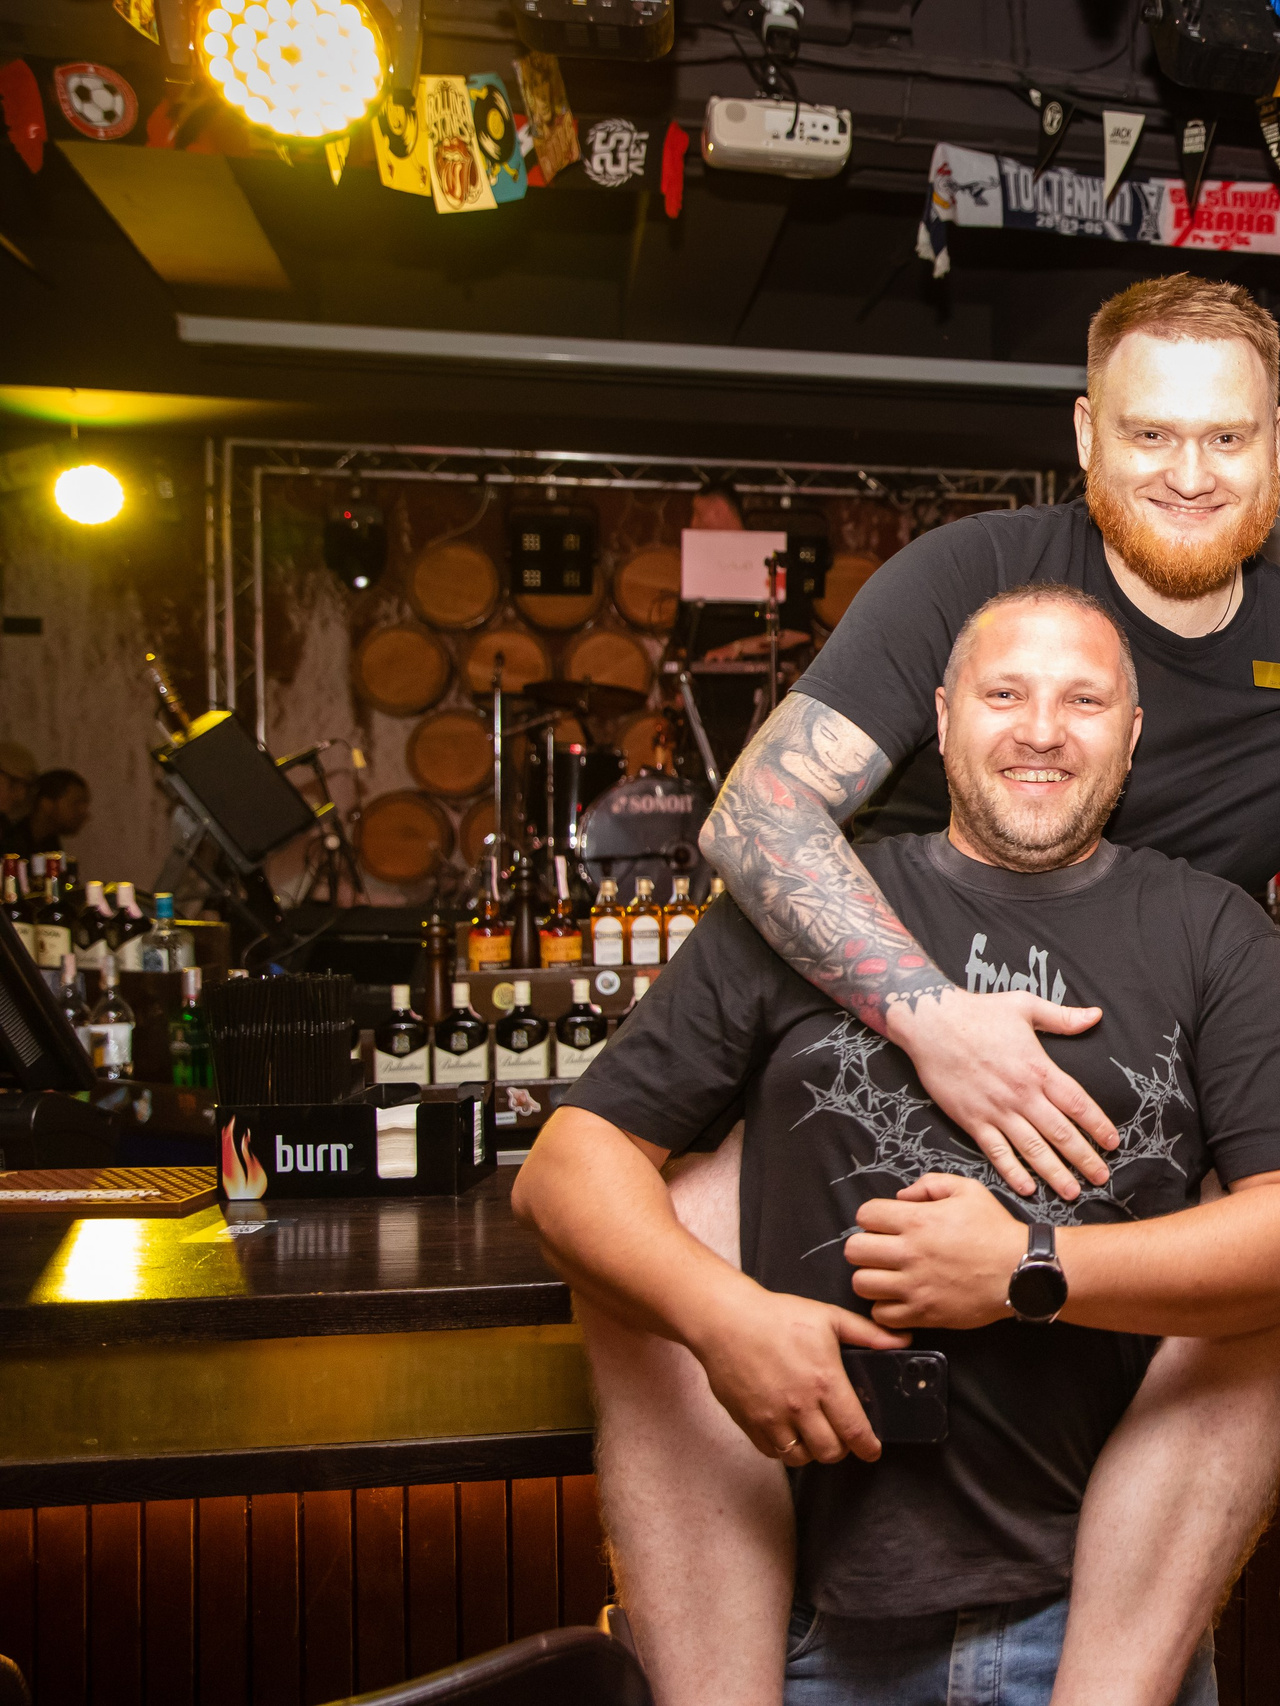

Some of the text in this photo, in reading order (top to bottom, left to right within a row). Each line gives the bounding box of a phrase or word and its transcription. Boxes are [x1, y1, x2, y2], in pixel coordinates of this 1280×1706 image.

[1110, 127, 1132, 138] JACK
[595, 130, 631, 175] 25
[1174, 209, 1275, 234] PRAHA
[275, 1134, 349, 1173] burn
